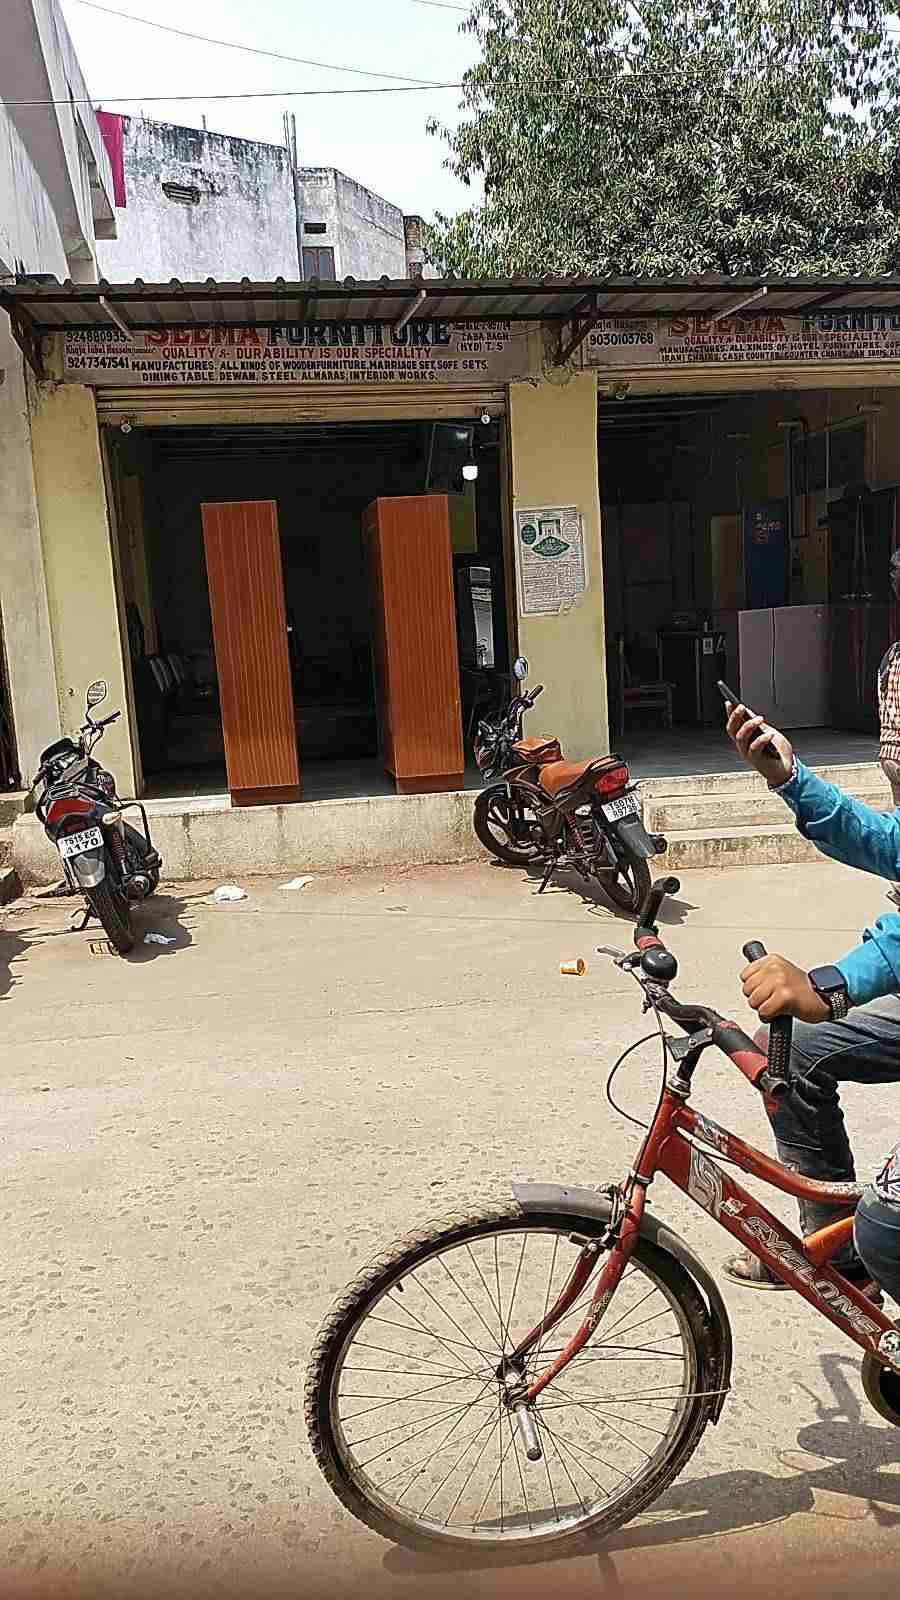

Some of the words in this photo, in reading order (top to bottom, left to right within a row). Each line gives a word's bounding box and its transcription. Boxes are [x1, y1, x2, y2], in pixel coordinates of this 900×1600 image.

[143, 327, 260, 347] SEEMA
[266, 323, 450, 347] FURNITURE
[685, 336, 724, 345] QUALITY
[735, 335, 789, 343] DURABILITY
[823, 332, 889, 341] SPECIALITY
[162, 348, 214, 360] QUALITY
[236, 348, 315, 359] DURABILITY
[319, 348, 330, 358] IS
[336, 347, 359, 358] OUR
[365, 347, 432, 358] SPECIALITY
[67, 357, 129, 369] 9247347541
[220, 361, 239, 370] ALL
[240, 360, 266, 370] KINDS
[268, 361, 280, 369] OF
[142, 372, 178, 381] DINING
[261, 372, 297, 380] STEEL
[349, 371, 395, 380] INTERIOR
